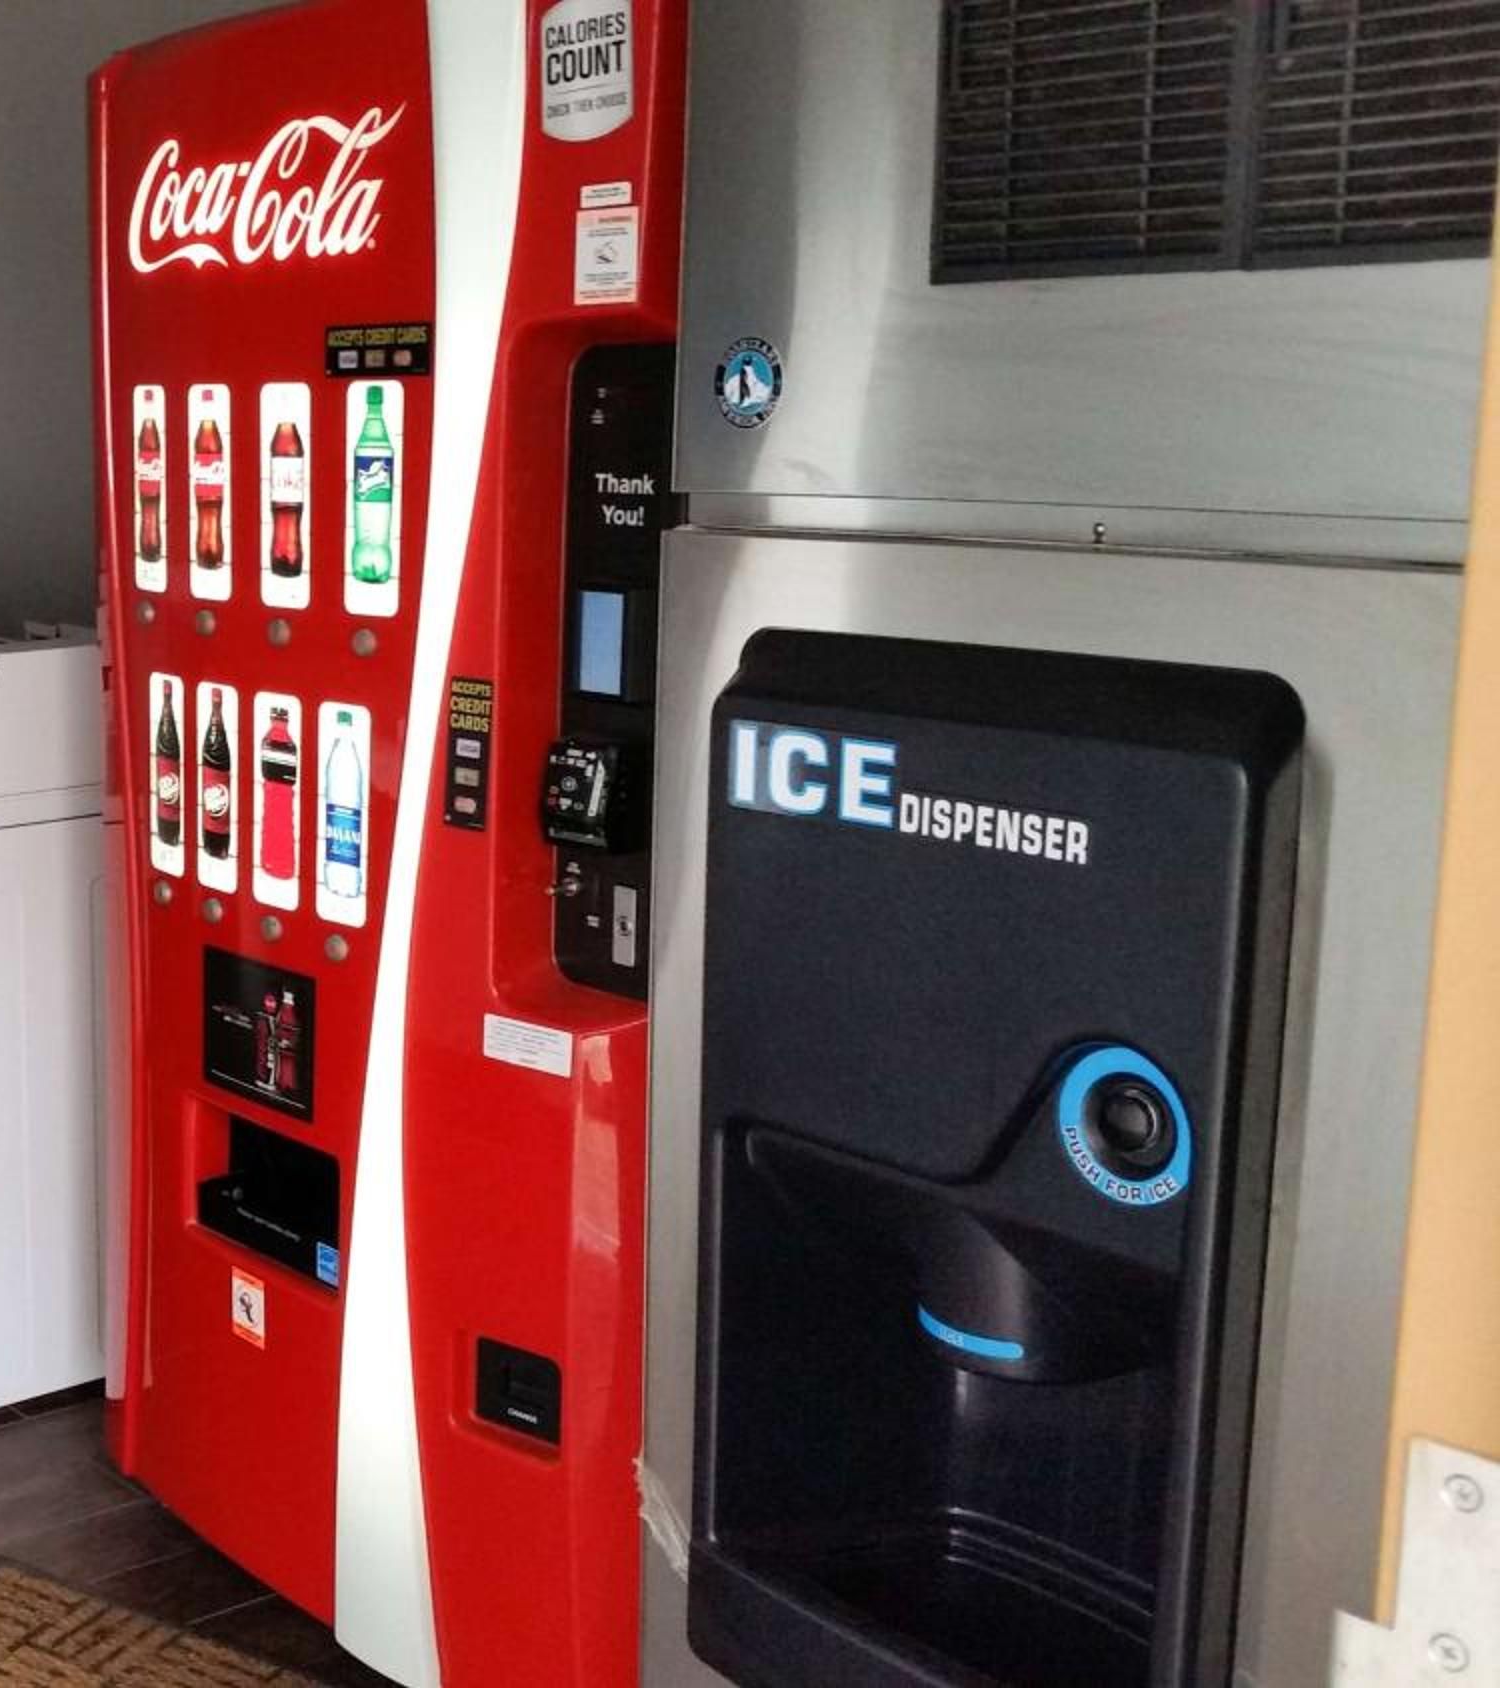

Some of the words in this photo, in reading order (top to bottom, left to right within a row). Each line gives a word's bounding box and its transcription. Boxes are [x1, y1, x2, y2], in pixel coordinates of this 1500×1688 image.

[546, 11, 625, 49] CALORIES
[547, 40, 626, 85] COUNT
[128, 102, 407, 273] Coca-Cola
[328, 329, 364, 348] ACCEPTS
[365, 327, 396, 346] CREDIT
[397, 325, 428, 345] CARDS
[595, 473, 654, 495] Thank
[602, 504, 645, 526] You!
[451, 681, 492, 697] ACCEPTS
[450, 696, 493, 716] CREDIT
[450, 713, 490, 733] CARDS
[729, 722, 897, 828] ICE
[900, 793, 1090, 864] DISPENSER
[1065, 1127, 1100, 1182] PUSH
[1105, 1179, 1143, 1200] FOR
[1149, 1175, 1178, 1200] ICE
